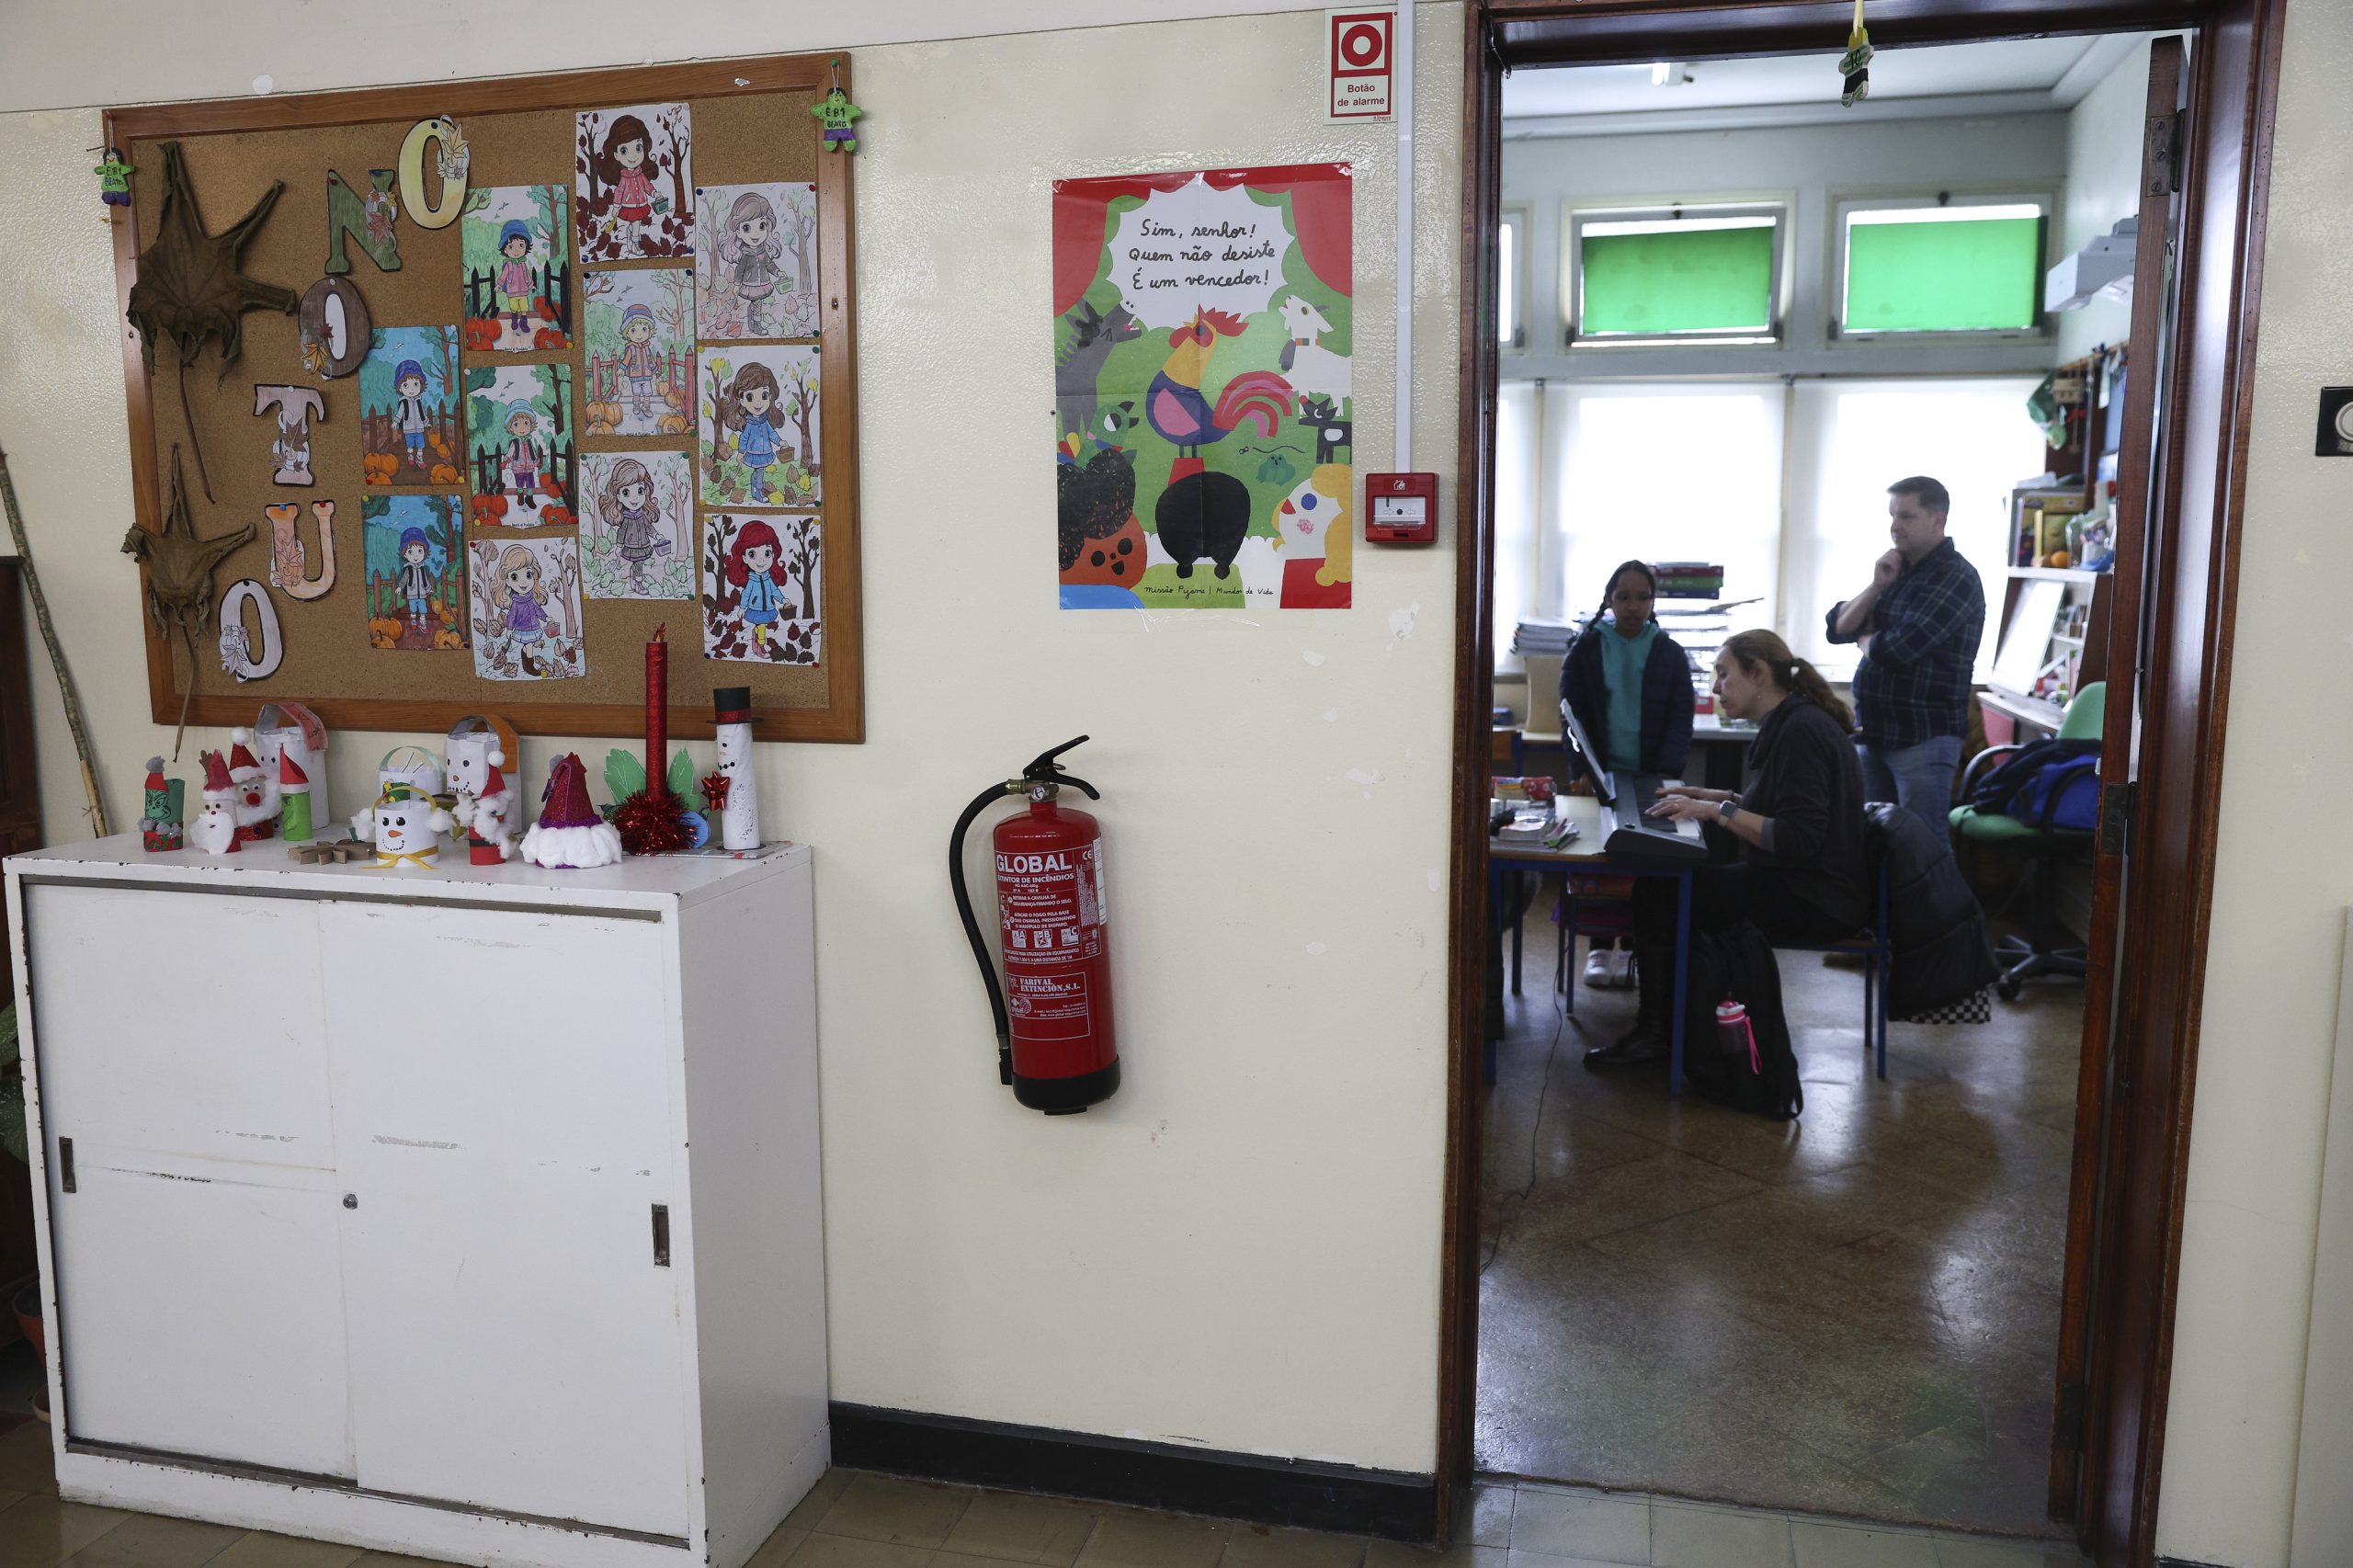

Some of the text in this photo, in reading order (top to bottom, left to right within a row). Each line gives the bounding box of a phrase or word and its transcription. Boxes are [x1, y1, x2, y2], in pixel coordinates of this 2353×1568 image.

[1347, 84, 1375, 93] Botão
[1337, 97, 1385, 107] de alarme
[1140, 218, 1256, 239] Sim, senhor!
[1129, 240, 1276, 262] Quem não desiste
[1132, 267, 1269, 290] É um vencedor!
[1245, 586, 1254, 595] de
[996, 853, 1073, 873] GLOBAL
[1032, 872, 1074, 883] INCÊNDIOS
[1044, 930, 1051, 938] B
[1071, 926, 1077, 935] C
[1019, 977, 1053, 985] FARIVAL
